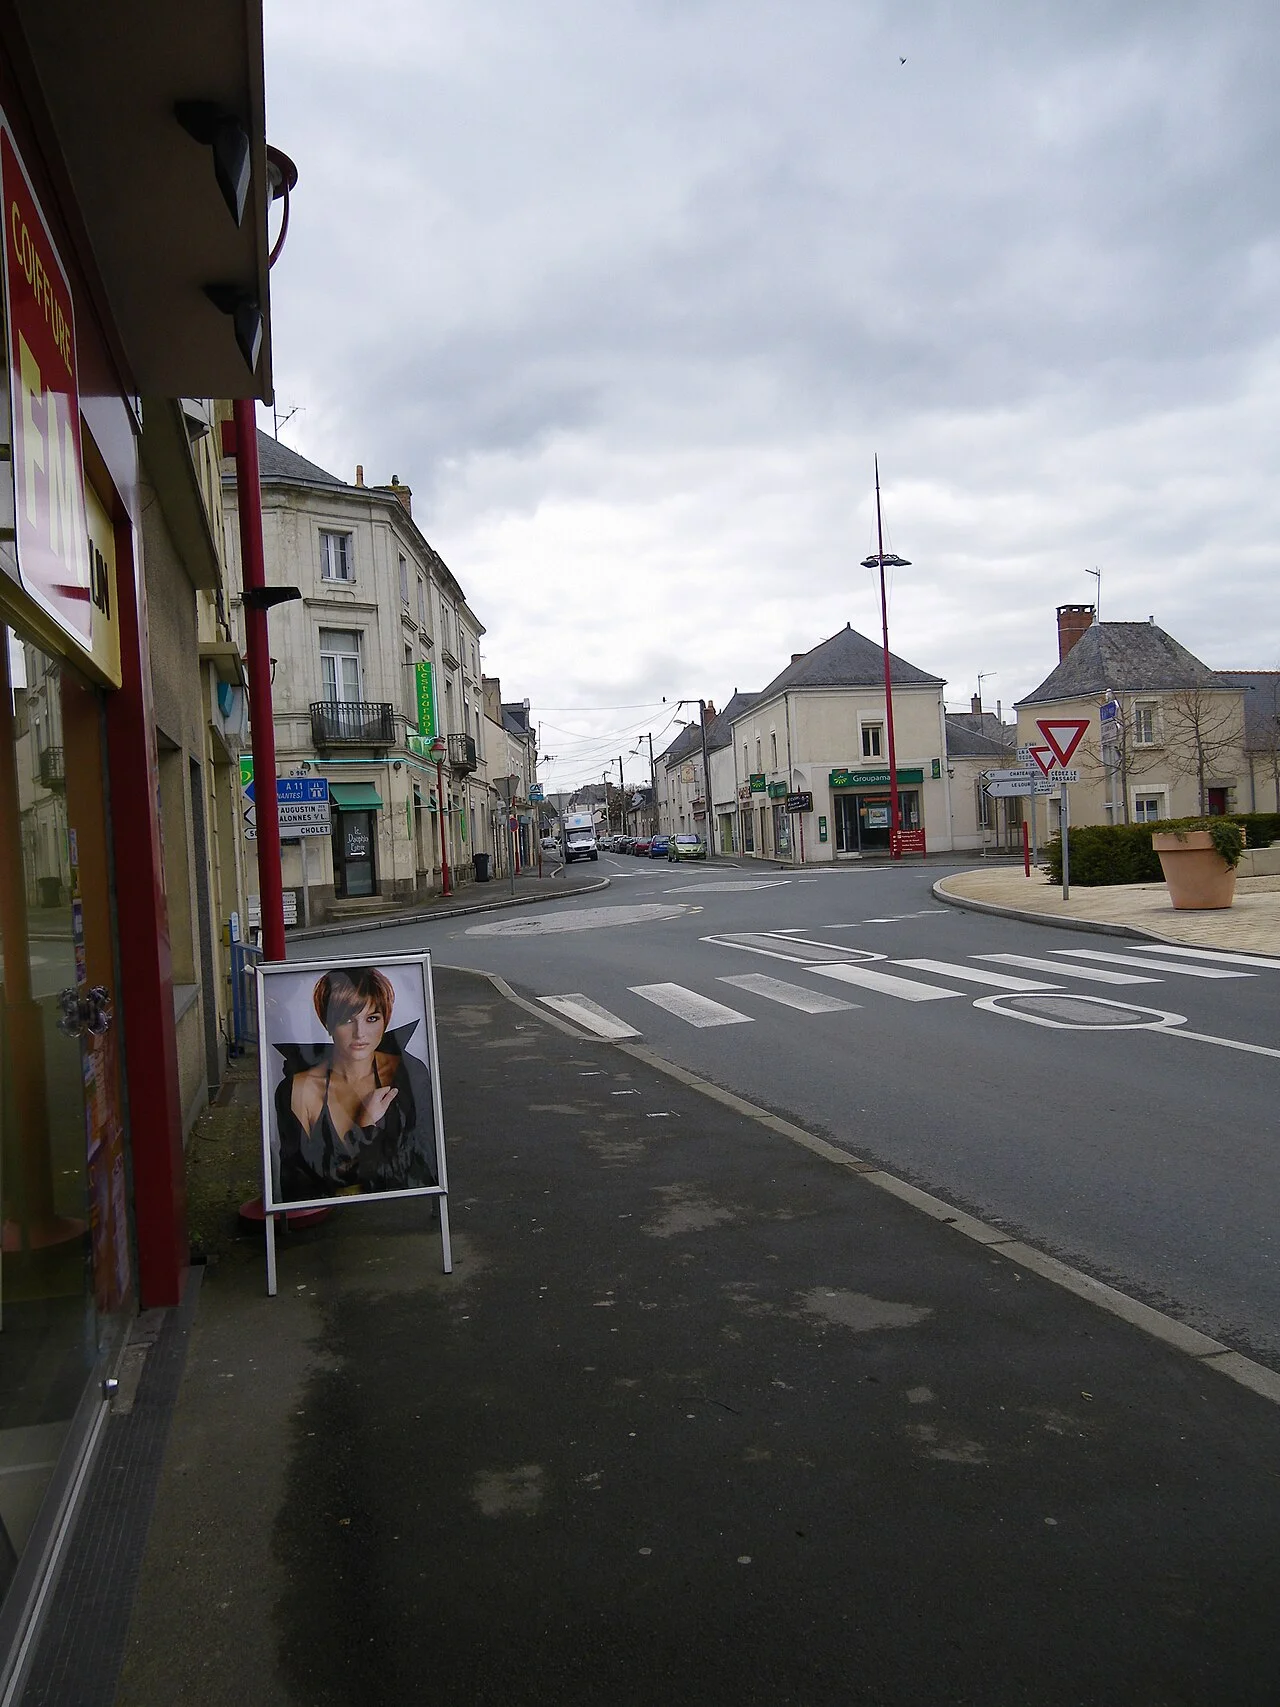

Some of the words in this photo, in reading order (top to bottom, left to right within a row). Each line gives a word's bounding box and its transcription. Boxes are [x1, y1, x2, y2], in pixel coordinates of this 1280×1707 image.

[11, 201, 73, 377] COIFFURE
[18, 329, 86, 589] FM
[417, 663, 432, 735] Restaurant
[294, 782, 304, 790] 11
[852, 774, 891, 783] Groupama
[280, 805, 316, 814] AUGUSTIN
